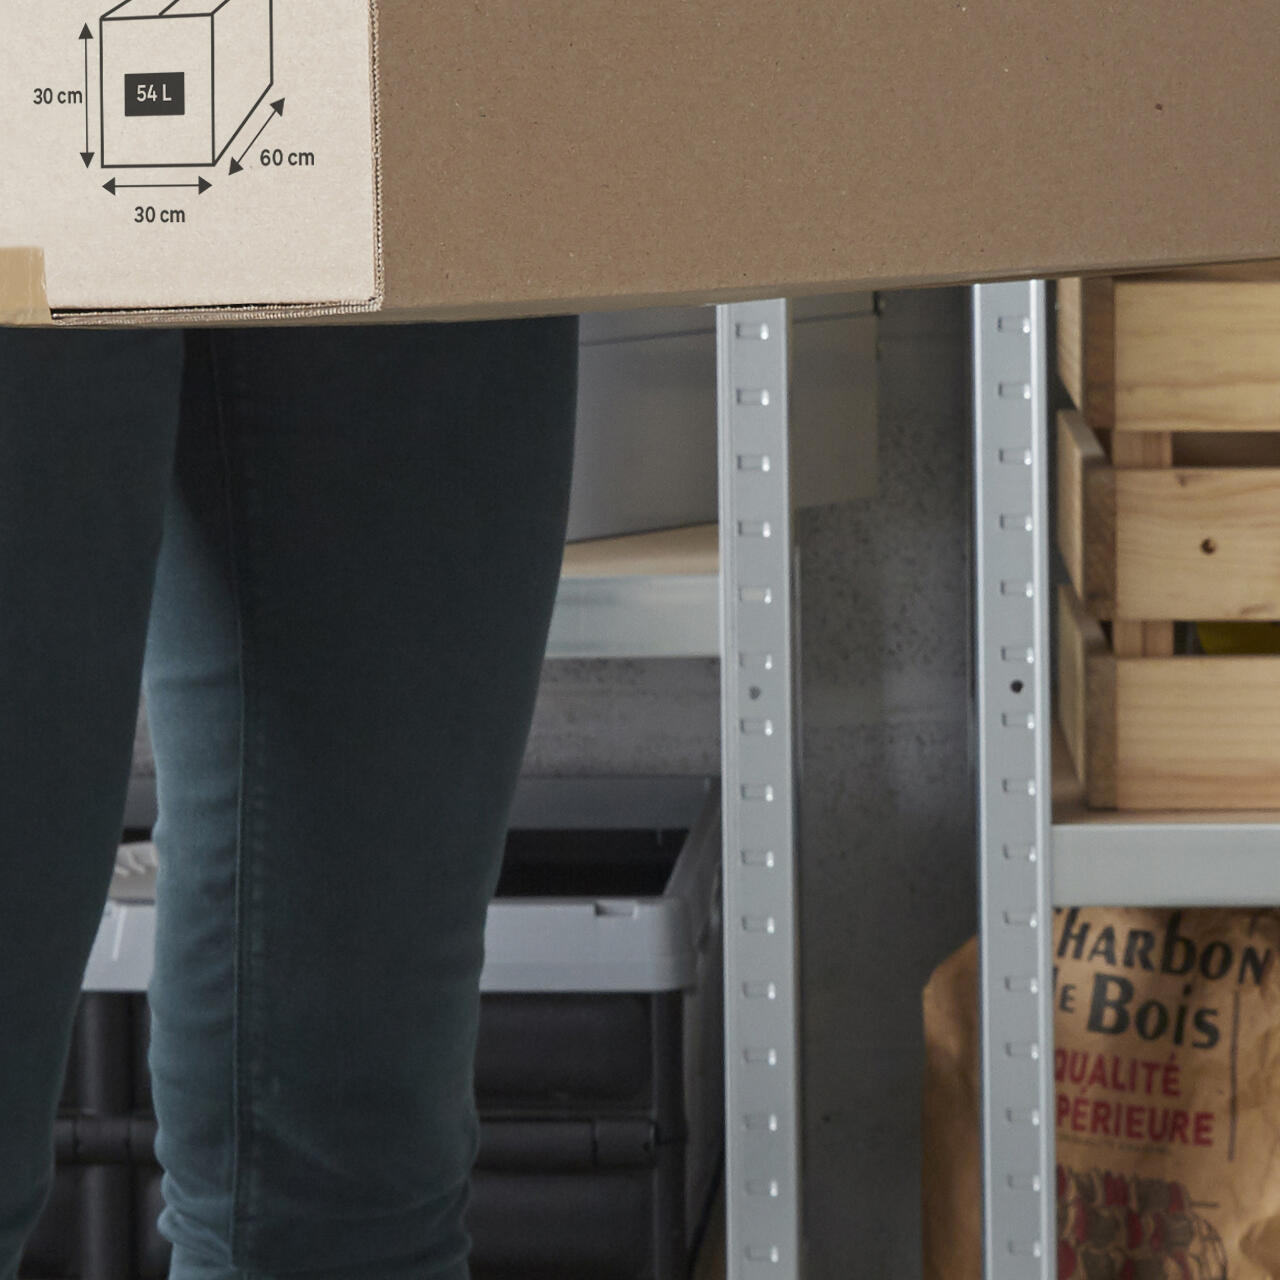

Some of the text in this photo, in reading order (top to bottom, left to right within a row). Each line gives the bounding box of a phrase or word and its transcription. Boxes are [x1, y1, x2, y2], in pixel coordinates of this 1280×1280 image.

[33, 88, 83, 105] 30 cm
[136, 84, 172, 102] 54 L
[259, 150, 315, 167] 60 cm
[134, 206, 186, 223] 30 cm
[1055, 1048, 1182, 1097] QUALITÉ
